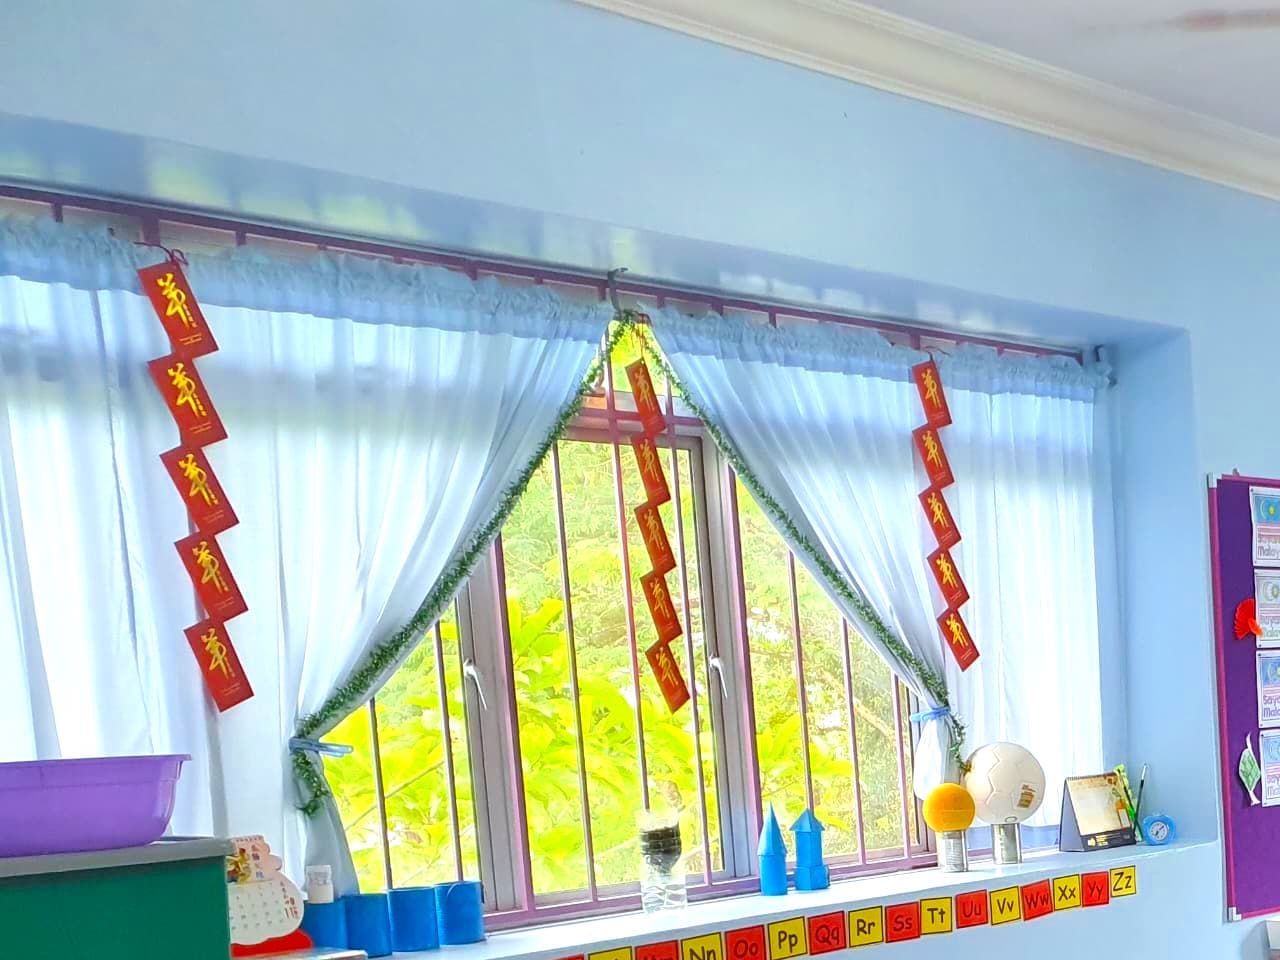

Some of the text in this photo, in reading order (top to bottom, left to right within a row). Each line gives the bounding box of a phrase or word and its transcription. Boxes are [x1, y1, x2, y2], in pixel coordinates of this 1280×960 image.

[733, 939, 759, 958] Oo
[777, 930, 798, 953] Pp
[815, 923, 840, 946] Qq
[856, 918, 876, 937] Rr
[893, 914, 913, 932] Ss
[927, 907, 946, 925] Tt
[962, 900, 982, 918] Uu
[996, 897, 1014, 915] Vv
[1025, 890, 1050, 909] Ww
[1058, 884, 1076, 901] Xx
[1087, 881, 1104, 897] Yy
[1112, 872, 1132, 892] Zz
